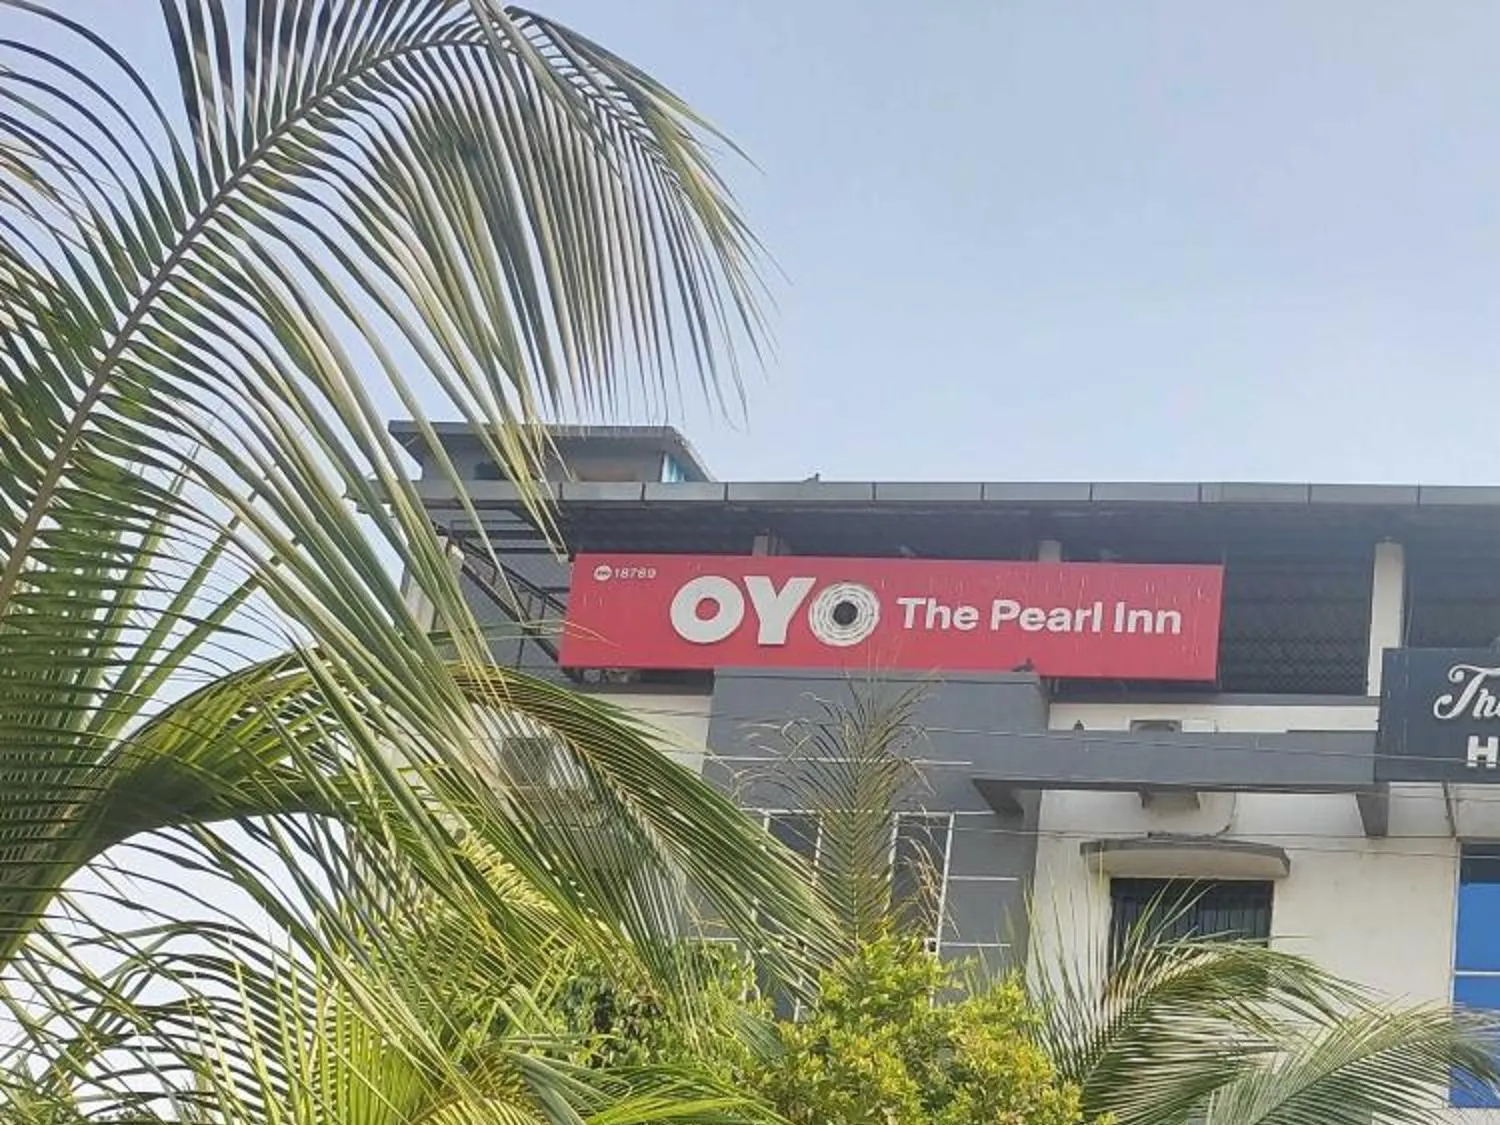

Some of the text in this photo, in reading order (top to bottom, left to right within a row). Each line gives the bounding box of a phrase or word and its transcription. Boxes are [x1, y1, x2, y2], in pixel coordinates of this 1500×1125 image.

[669, 575, 1181, 647] OYO The Pearl Inn
